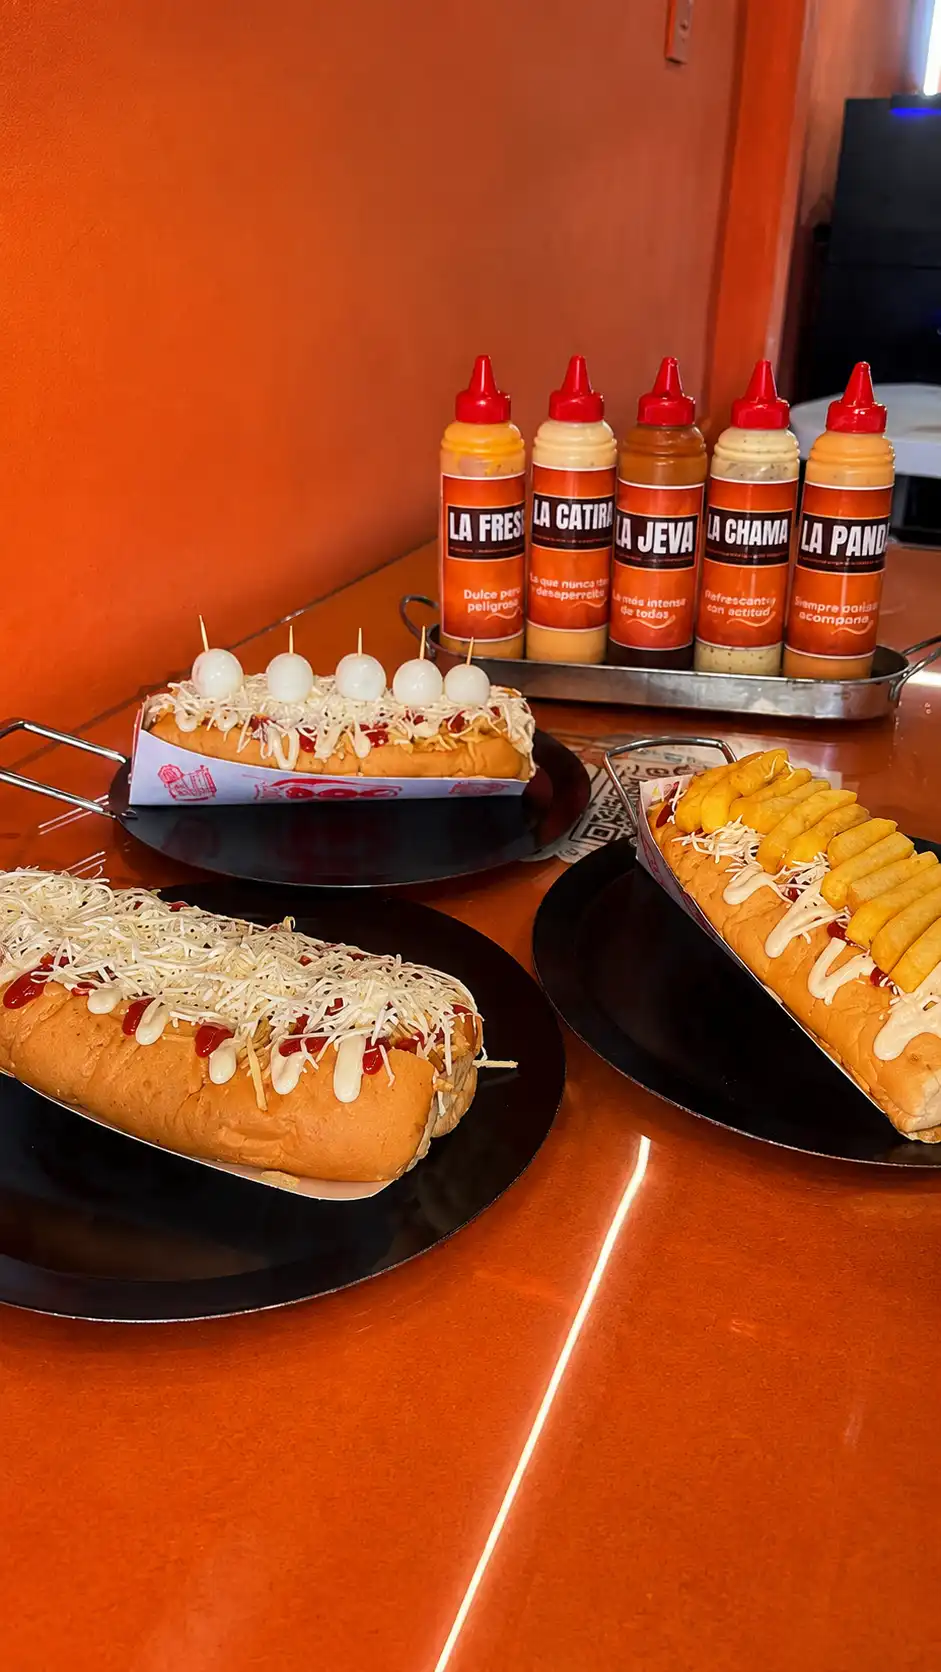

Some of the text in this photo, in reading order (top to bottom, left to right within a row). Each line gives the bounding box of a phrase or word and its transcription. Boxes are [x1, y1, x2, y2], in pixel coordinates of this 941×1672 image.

[449, 512, 472, 542] LA
[533, 499, 613, 530] LA CATIRA
[707, 513, 789, 546] LA CHAMA
[615, 515, 693, 555] LA JEVA
[801, 519, 823, 554] LA
[463, 589, 497, 600] Dulce
[540, 577, 559, 588] que
[561, 580, 595, 589] nunca
[636, 608, 669, 619] todas
[706, 604, 771, 617] con actitud
